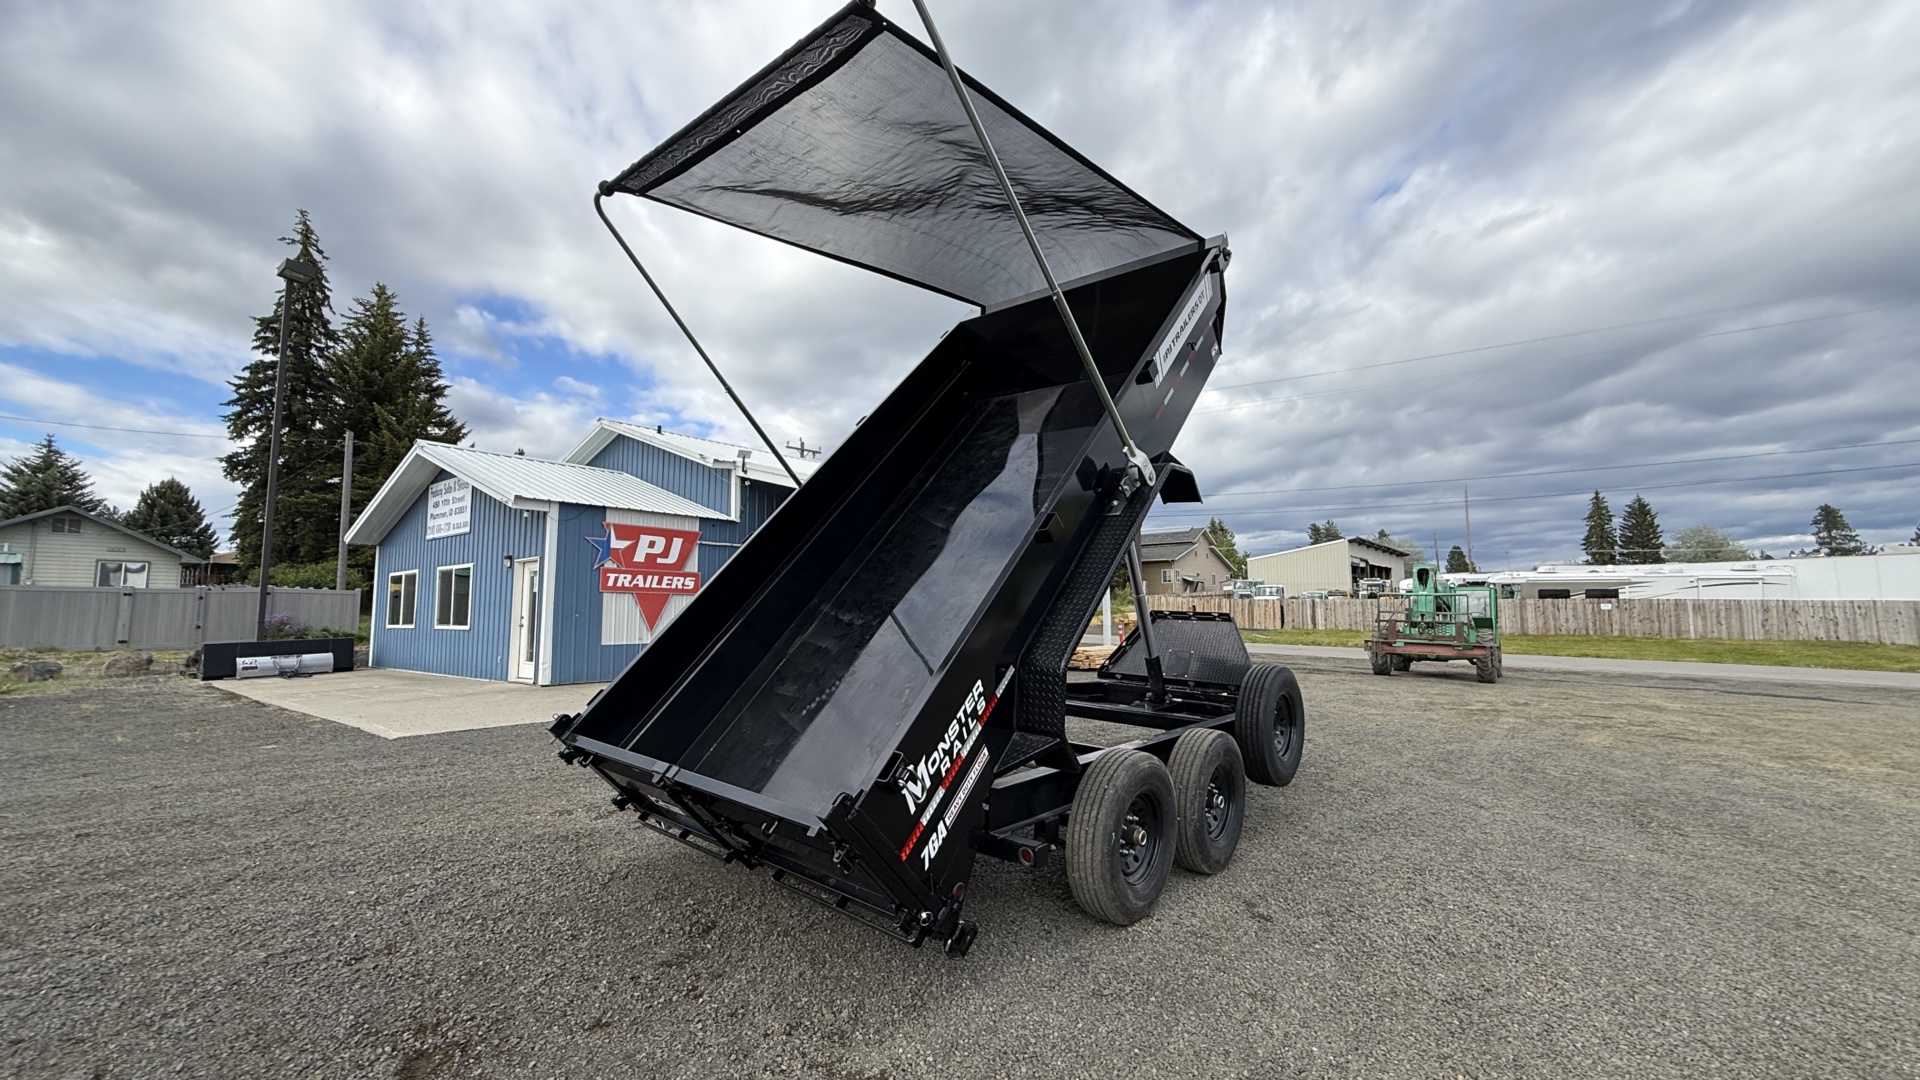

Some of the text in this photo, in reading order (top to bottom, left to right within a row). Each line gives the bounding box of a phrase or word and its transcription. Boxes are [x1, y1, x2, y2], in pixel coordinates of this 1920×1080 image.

[1171, 301, 1199, 348] TRAILERS
[452, 494, 466, 504] Street
[632, 534, 684, 564] PJ
[606, 573, 696, 590] TRAILERS
[940, 696, 986, 778] RAILS
[920, 751, 987, 872] 7GA HEAVY DUTY FLOOR
